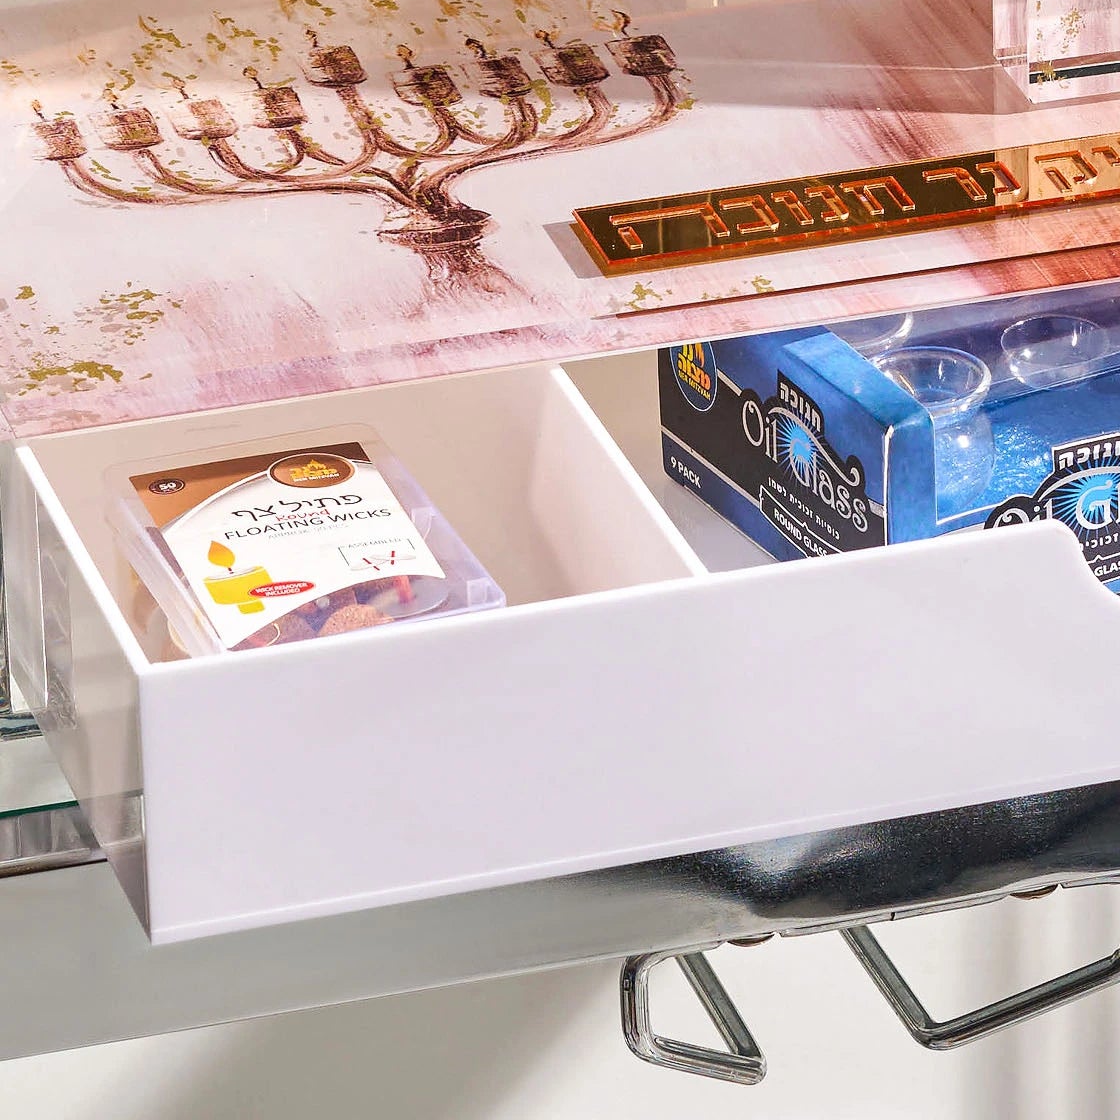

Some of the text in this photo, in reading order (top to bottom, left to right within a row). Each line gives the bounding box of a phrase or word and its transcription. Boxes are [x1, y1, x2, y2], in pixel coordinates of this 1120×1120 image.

[922, 160, 1024, 204] נר
[608, 174, 916, 251] חנוכה
[779, 381, 822, 433] חנוכה
[670, 456, 703, 489] 9 PACK
[741, 399, 868, 533] Oil Glass
[158, 482, 177, 491] 50
[231, 493, 364, 522] פתיל צף
[789, 494, 814, 519] זכוכית
[223, 516, 324, 540] FLOATING
[327, 508, 392, 524] WICKS
[774, 507, 803, 541] ROUND
[815, 513, 841, 541] כוסיות
